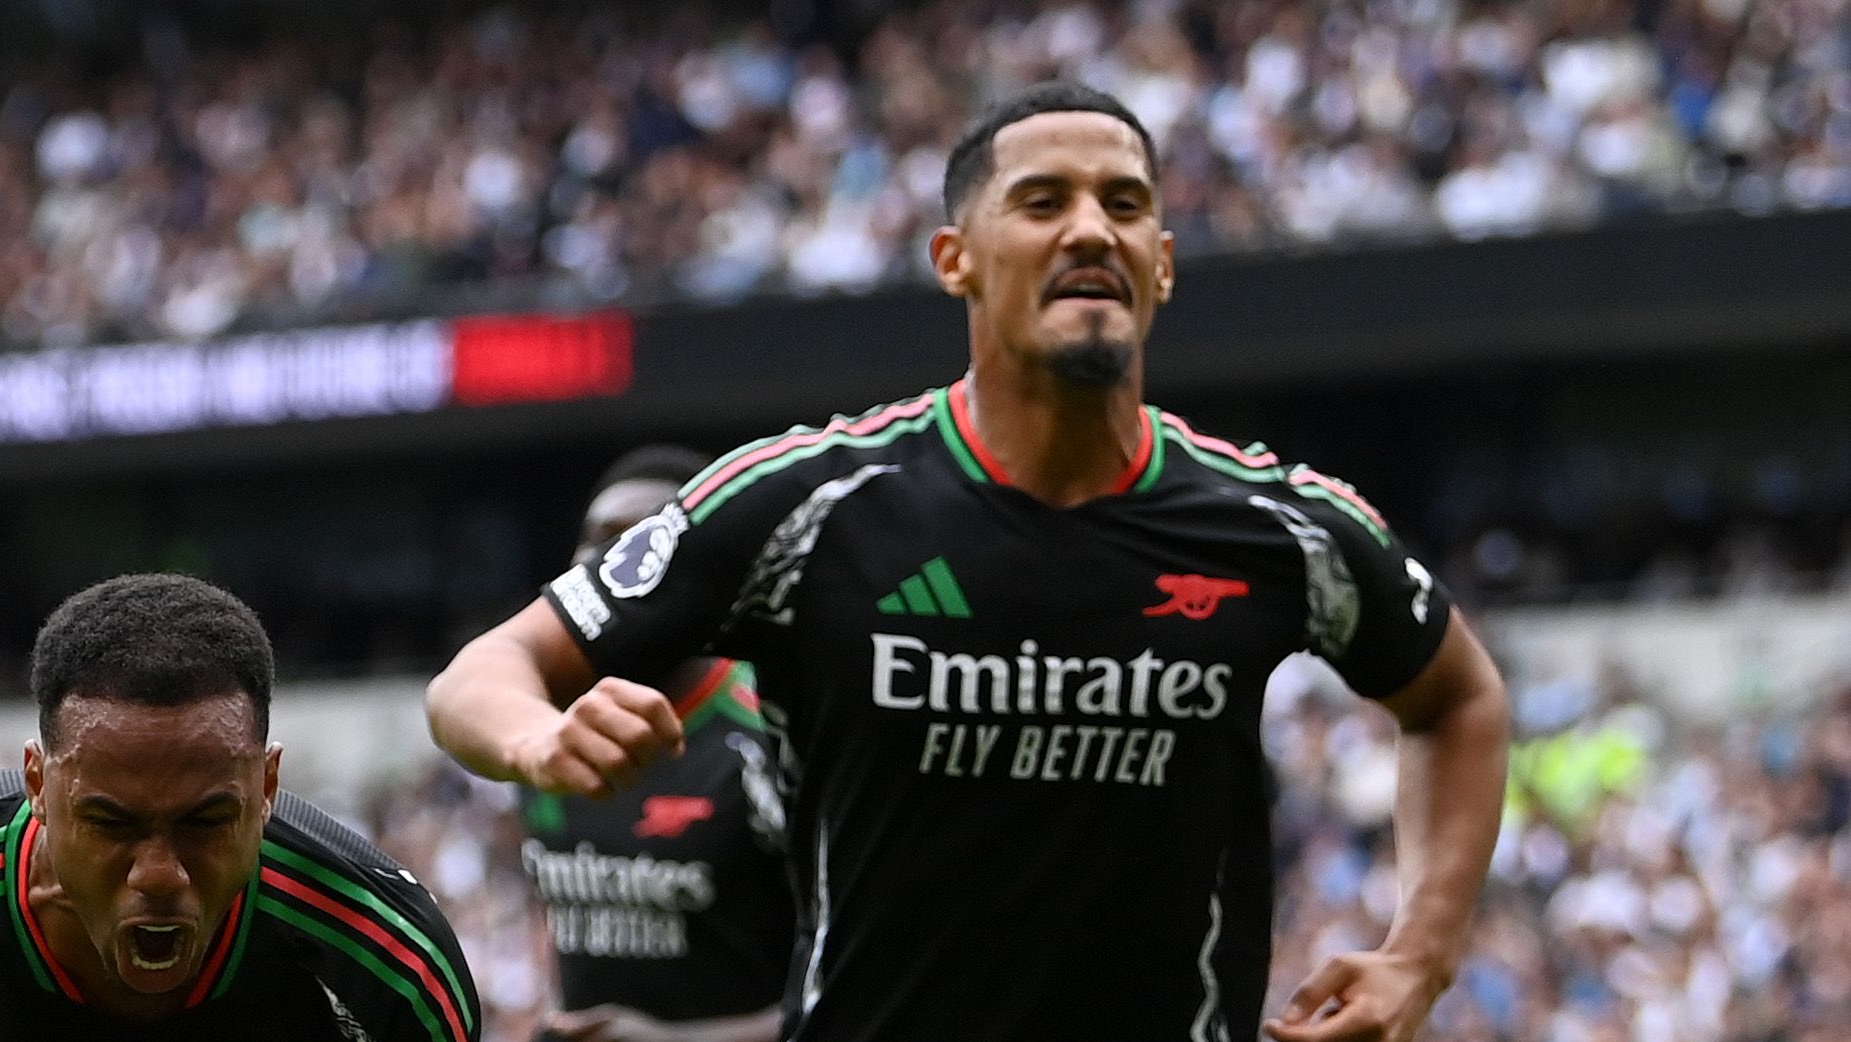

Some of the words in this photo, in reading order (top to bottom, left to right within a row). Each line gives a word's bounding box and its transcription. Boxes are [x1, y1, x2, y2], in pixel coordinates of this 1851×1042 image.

[870, 633, 1233, 720] Emirates
[918, 721, 1002, 776] FLY
[1009, 724, 1177, 787] BETTER
